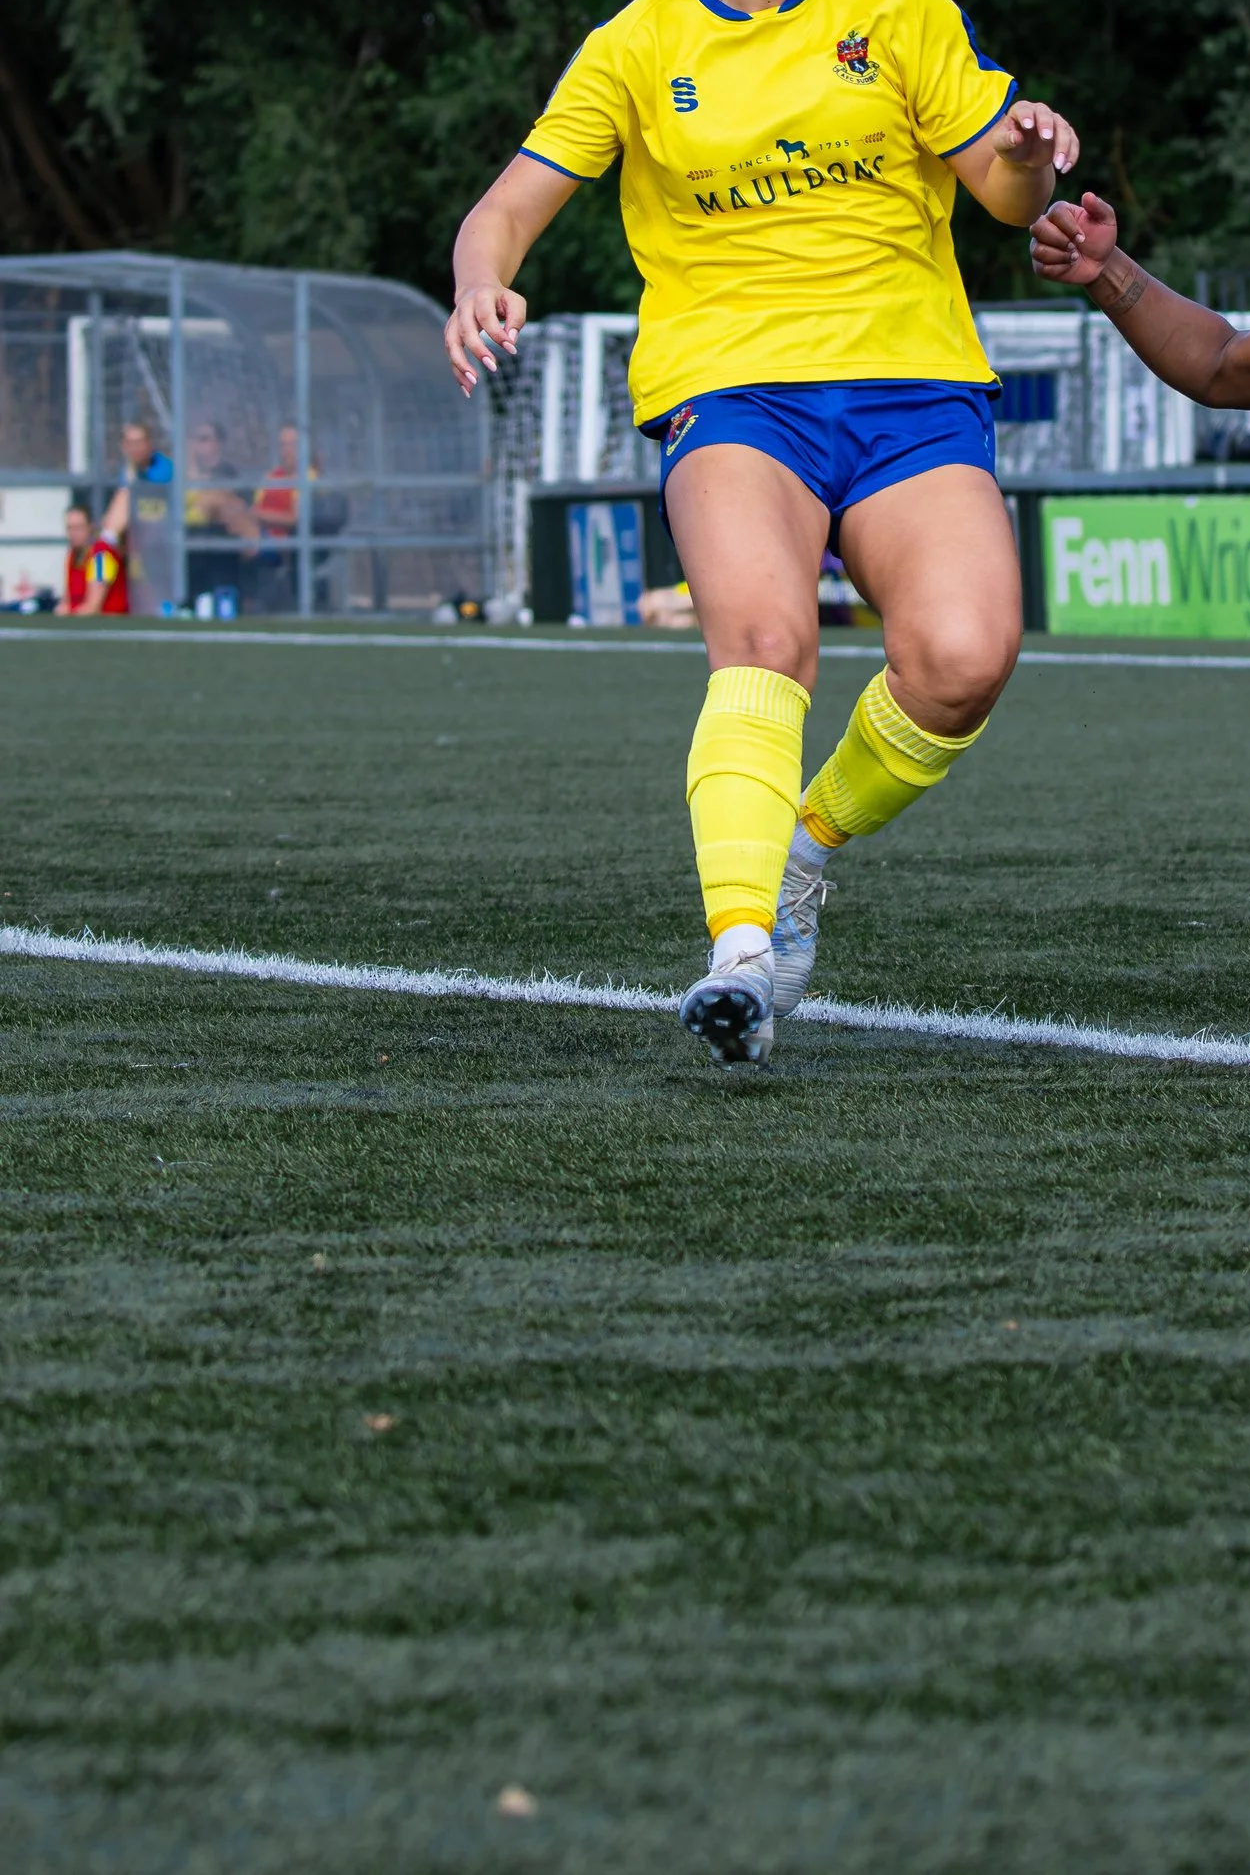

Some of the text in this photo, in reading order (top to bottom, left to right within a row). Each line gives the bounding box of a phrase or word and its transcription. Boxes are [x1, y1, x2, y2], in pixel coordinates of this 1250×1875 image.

[730, 139, 851, 172] SINCE 1795
[693, 154, 886, 216] MAULDONS
